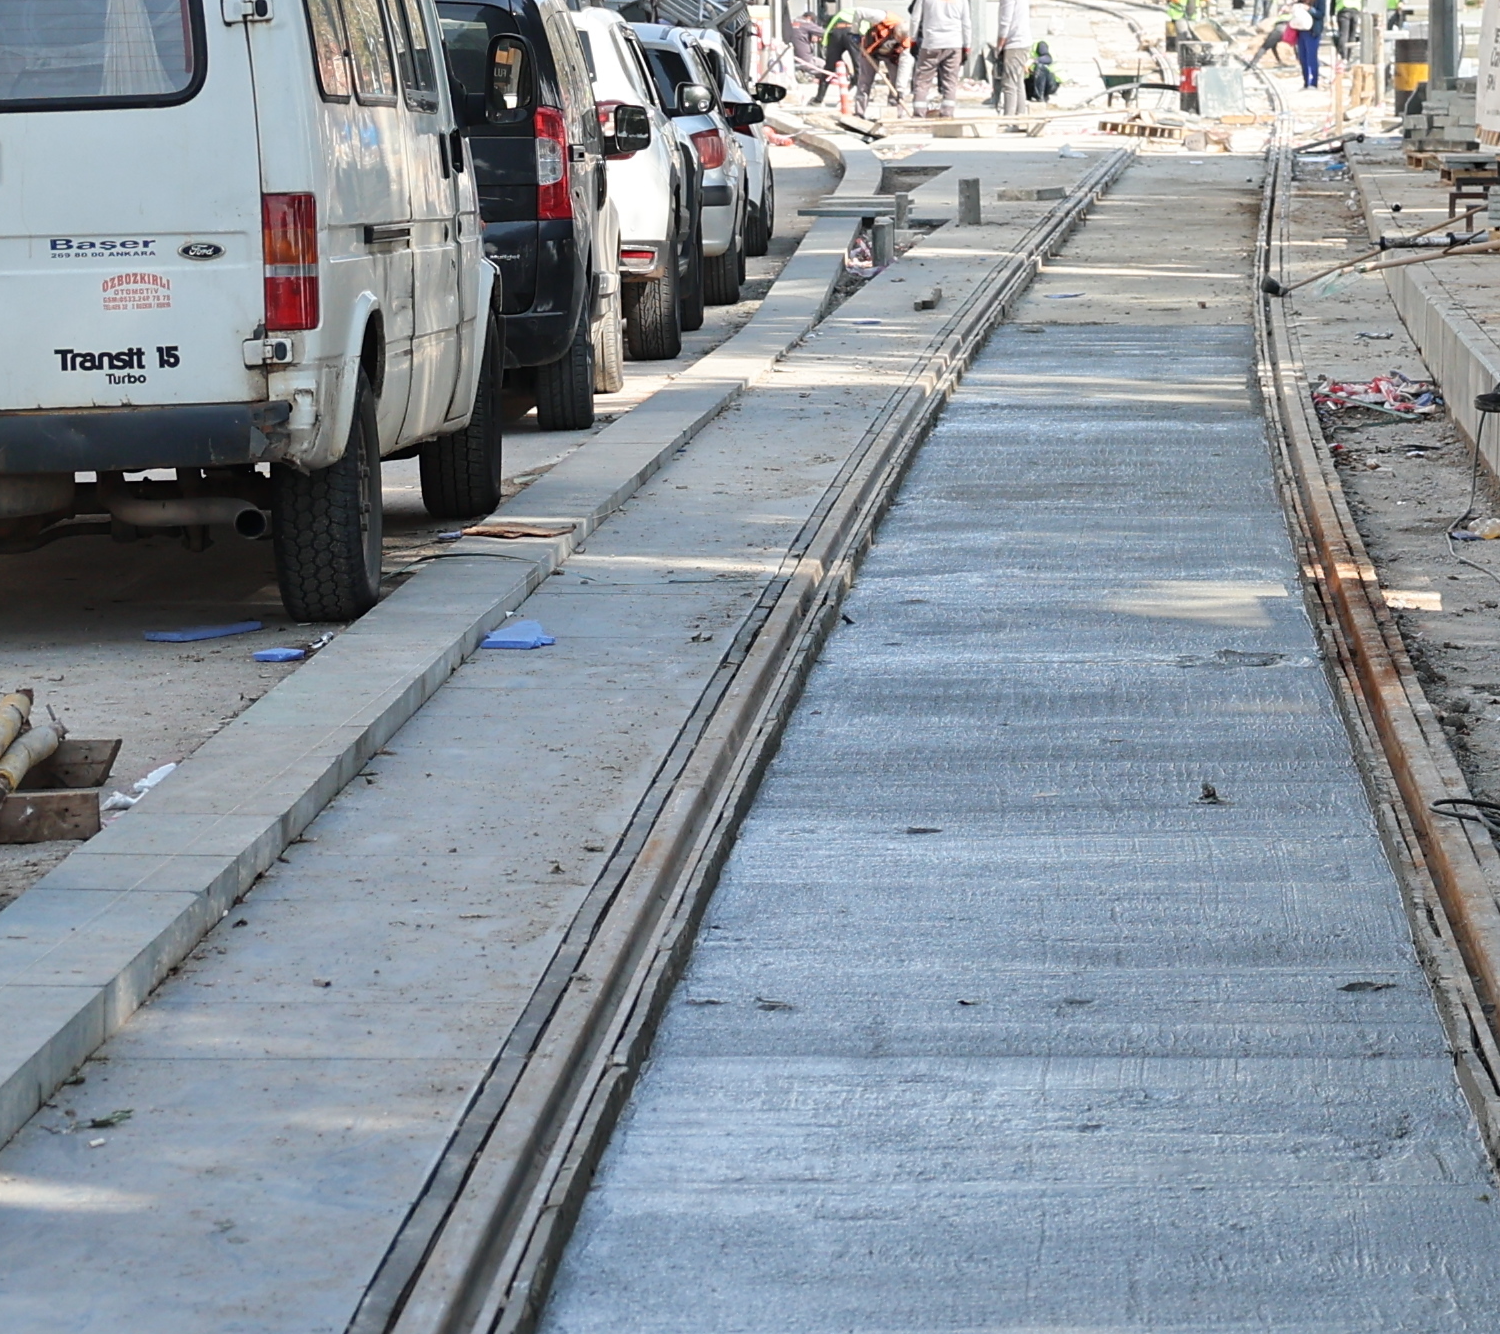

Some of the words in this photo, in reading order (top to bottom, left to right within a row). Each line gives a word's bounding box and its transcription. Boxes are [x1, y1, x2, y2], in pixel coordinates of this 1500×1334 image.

[50, 238, 156, 252] Başer
[188, 244, 214, 257] Ford
[51, 251, 71, 259] 269
[107, 250, 156, 258] ANKARA
[54, 347, 146, 372] Transit
[156, 345, 181, 369] 15
[105, 373, 147, 385] Turbo
